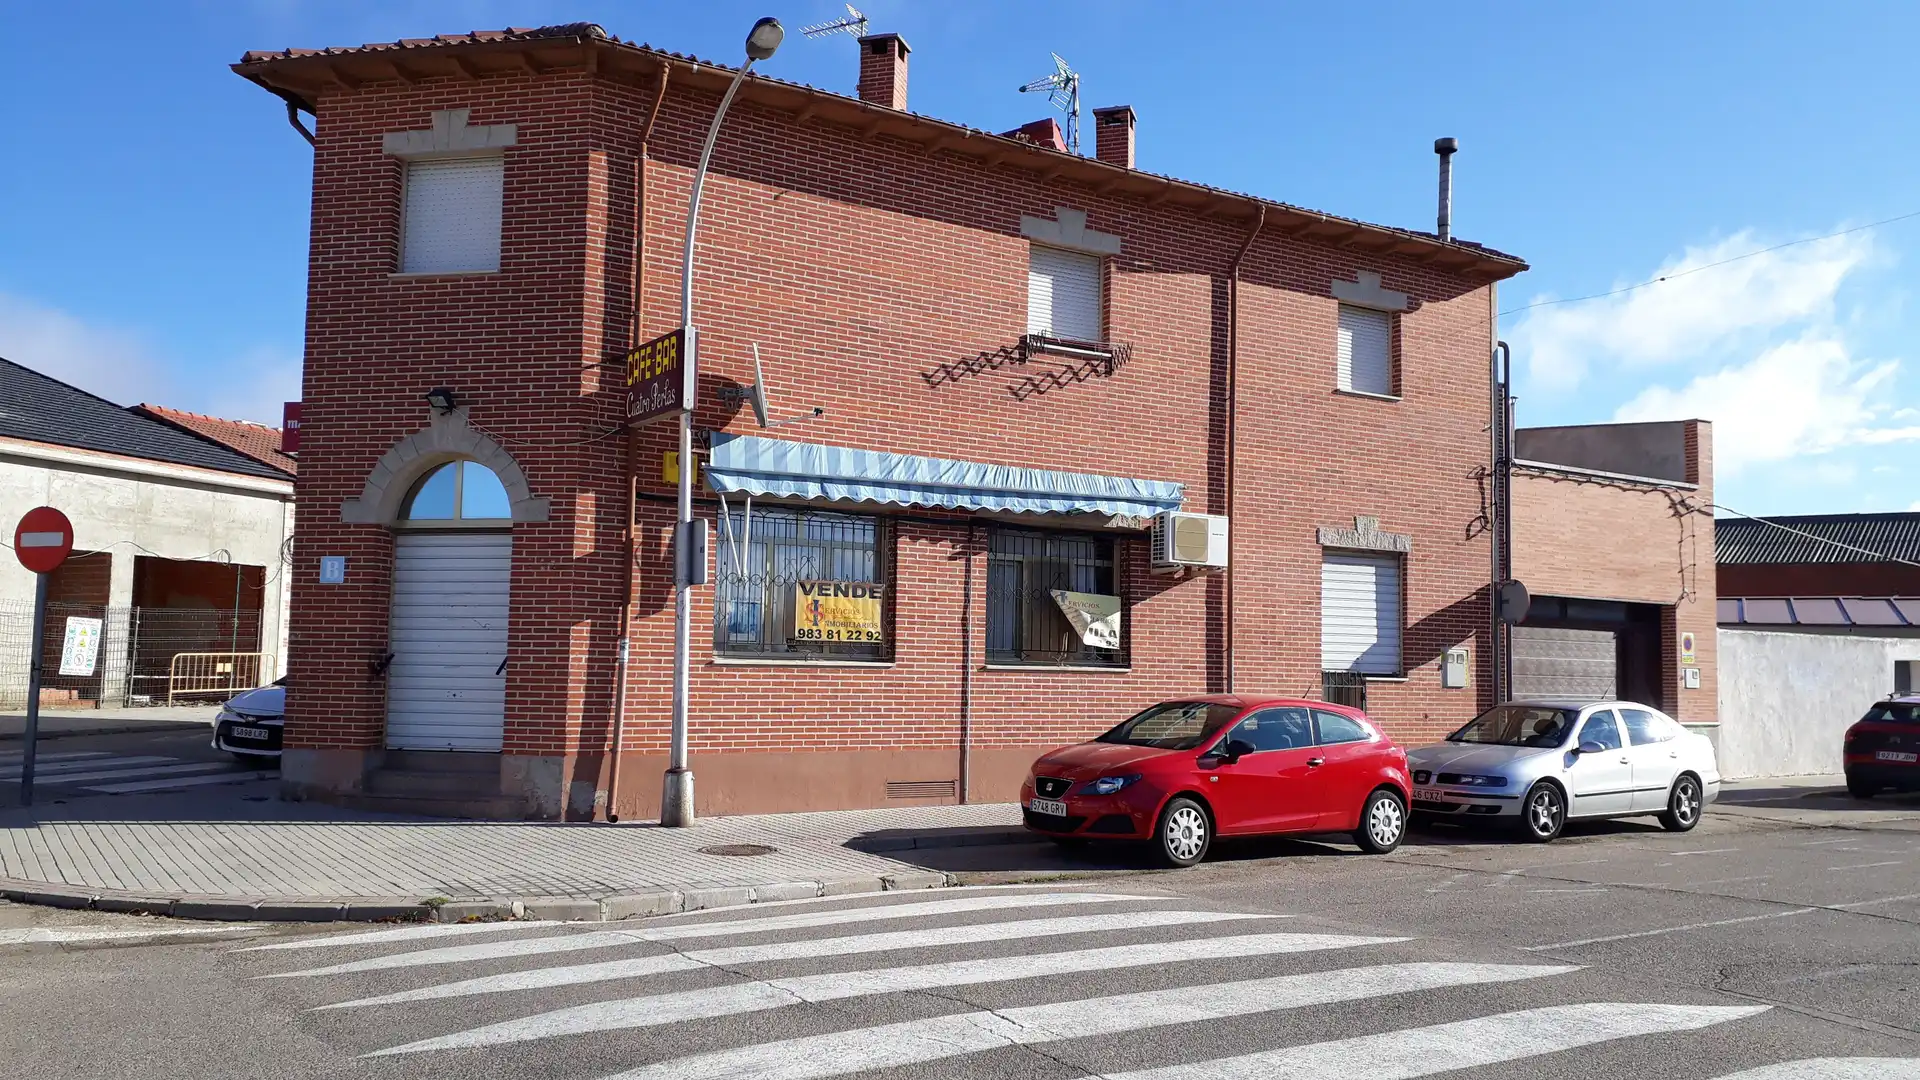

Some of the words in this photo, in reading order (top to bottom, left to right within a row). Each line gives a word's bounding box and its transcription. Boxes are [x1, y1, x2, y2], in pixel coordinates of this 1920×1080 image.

[626, 391, 650, 418] Cuatro
[651, 378, 676, 411] Perlas
[800, 582, 882, 599] VENDE
[798, 628, 822, 640] 983
[826, 629, 841, 641] 81
[846, 630, 862, 641] 22
[866, 631, 881, 641] 92
[1412, 789, 1423, 799] 46
[1032, 799, 1049, 813] 5748
[1050, 803, 1065, 815] GRV
